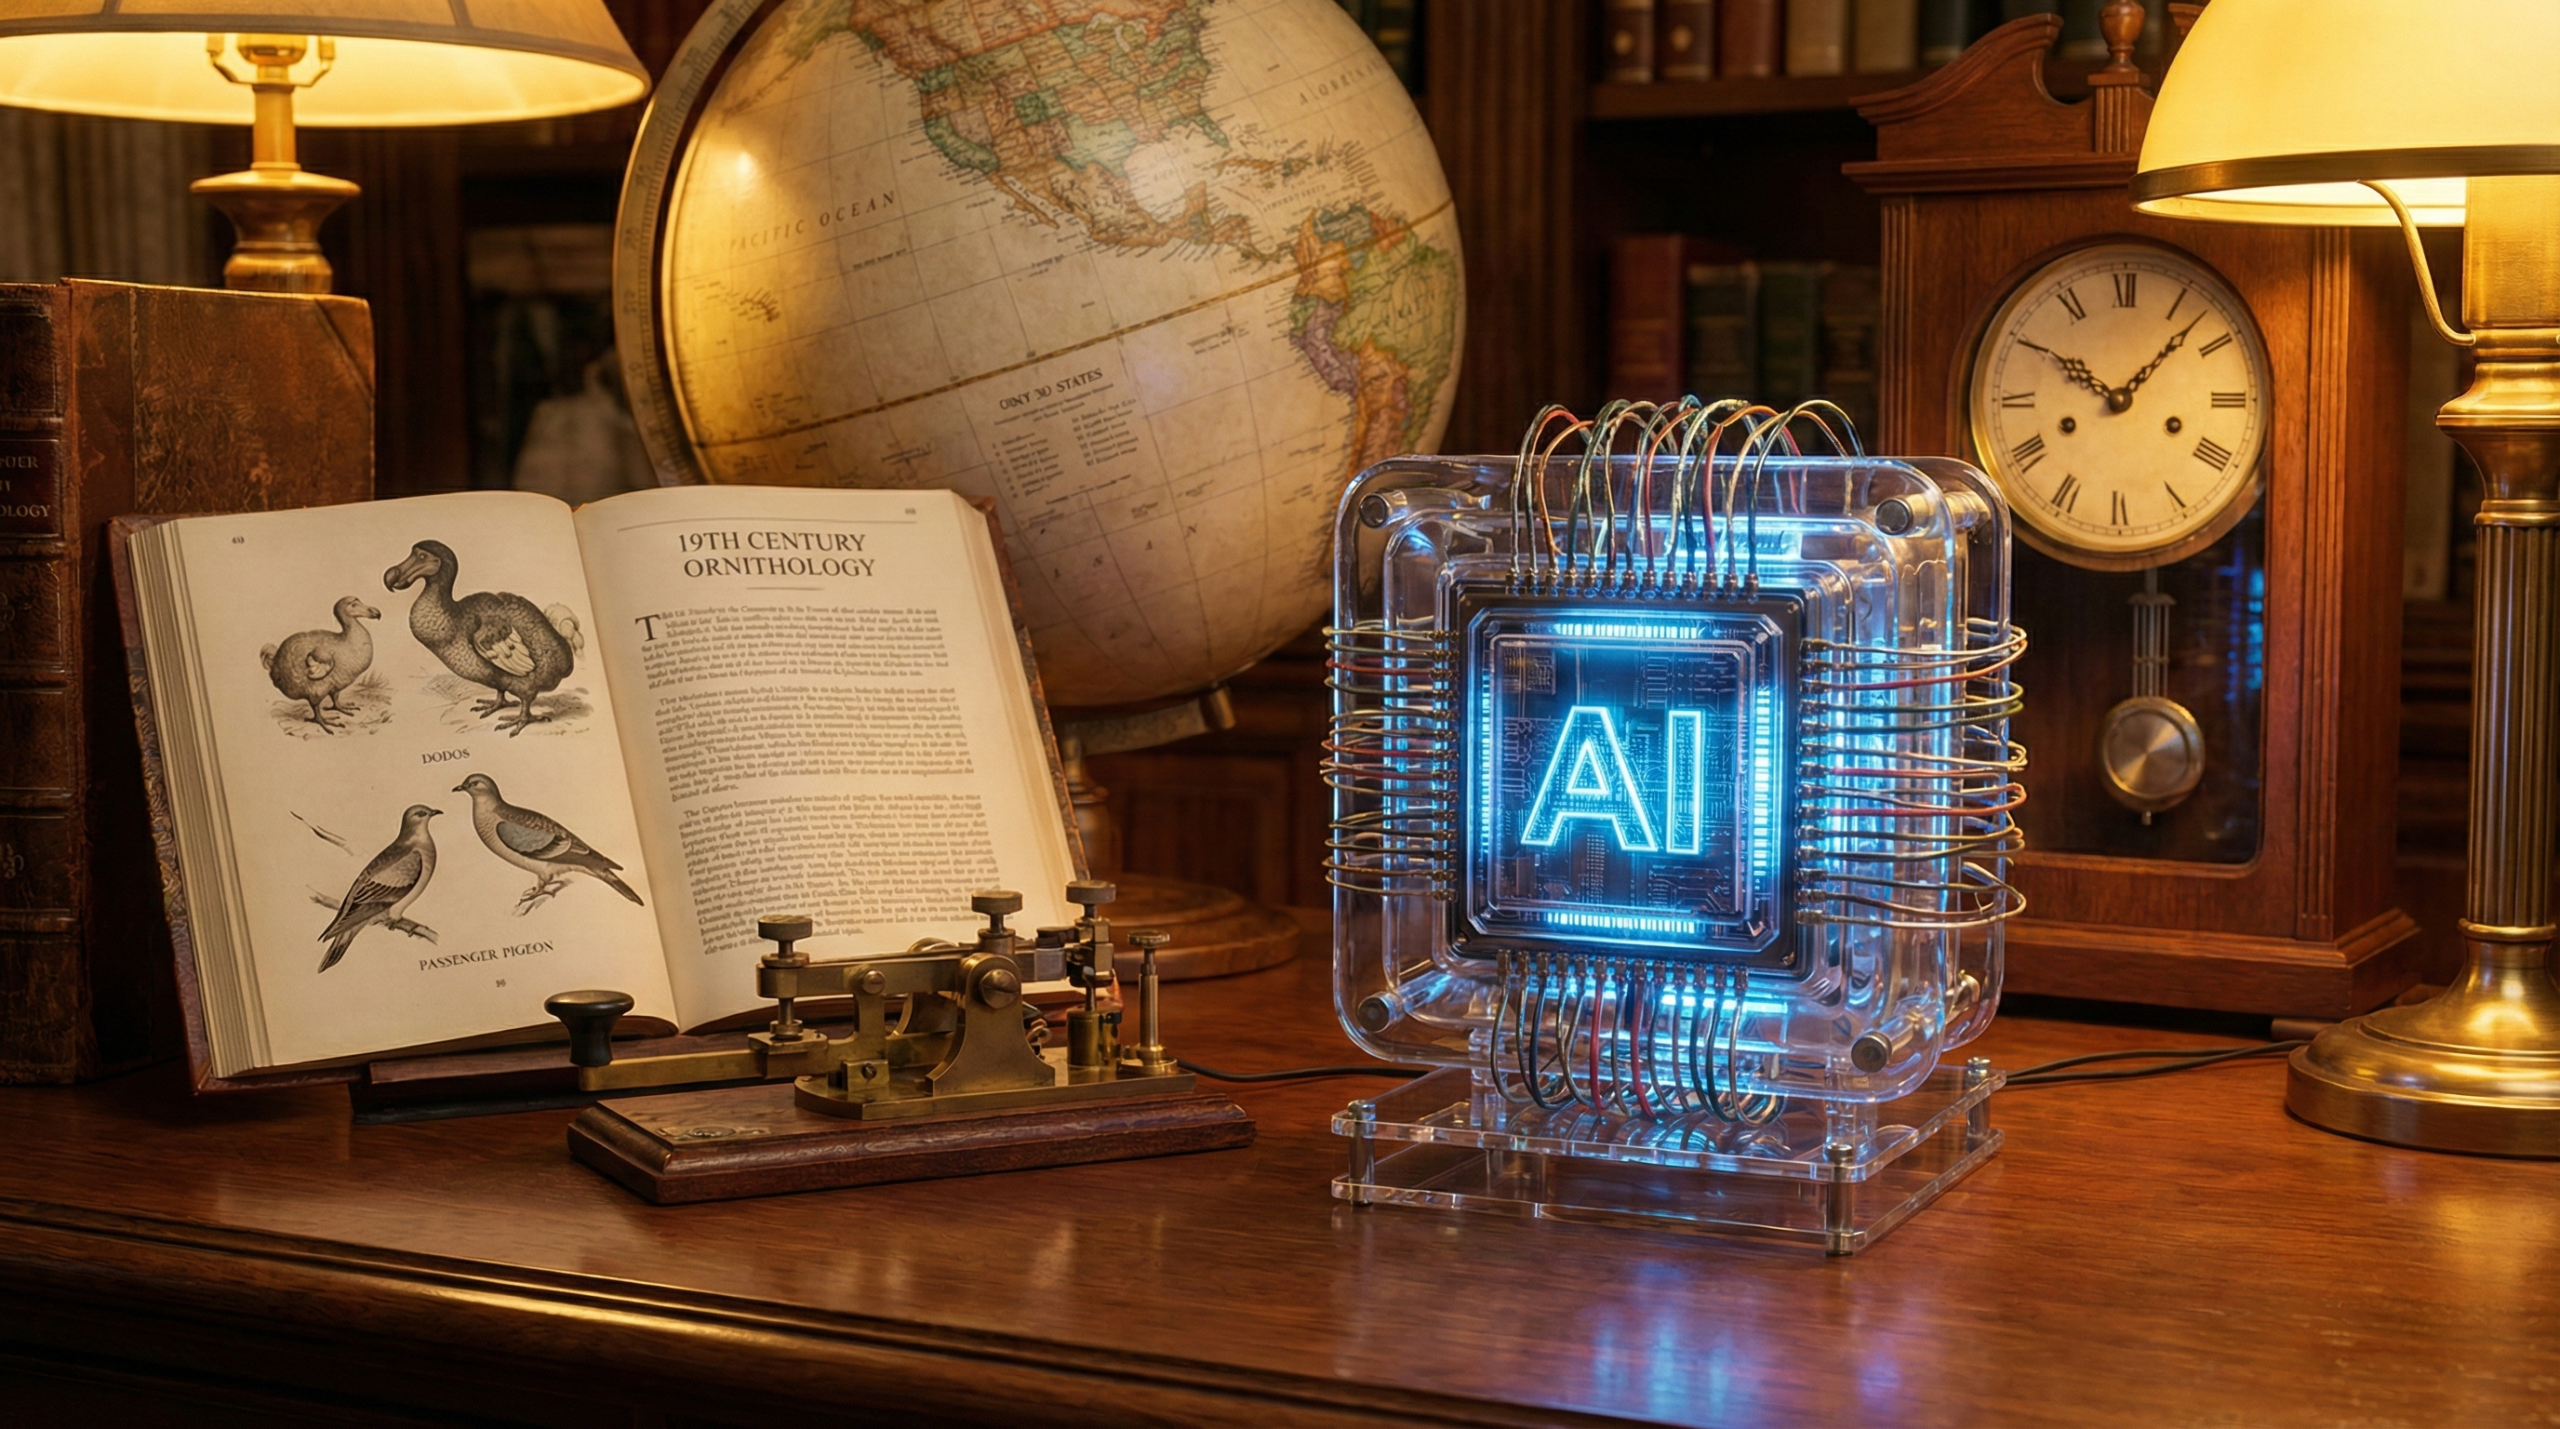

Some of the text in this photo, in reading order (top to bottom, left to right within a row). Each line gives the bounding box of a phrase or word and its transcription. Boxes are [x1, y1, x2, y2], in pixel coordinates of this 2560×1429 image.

[730, 190, 895, 250] PACIFIC OCEAN
[2111, 272, 2137, 308] XII
[2198, 332, 2233, 358] II
[1056, 367, 1103, 393] STATES
[2211, 391, 2246, 409] III
[678, 531, 867, 552] 19TH CENTURY
[683, 557, 876, 577] ORNITHOLOGY
[421, 748, 471, 764] DODOS
[1520, 704, 1702, 855] AI
[419, 939, 554, 971] PASSENGER PIGEON
